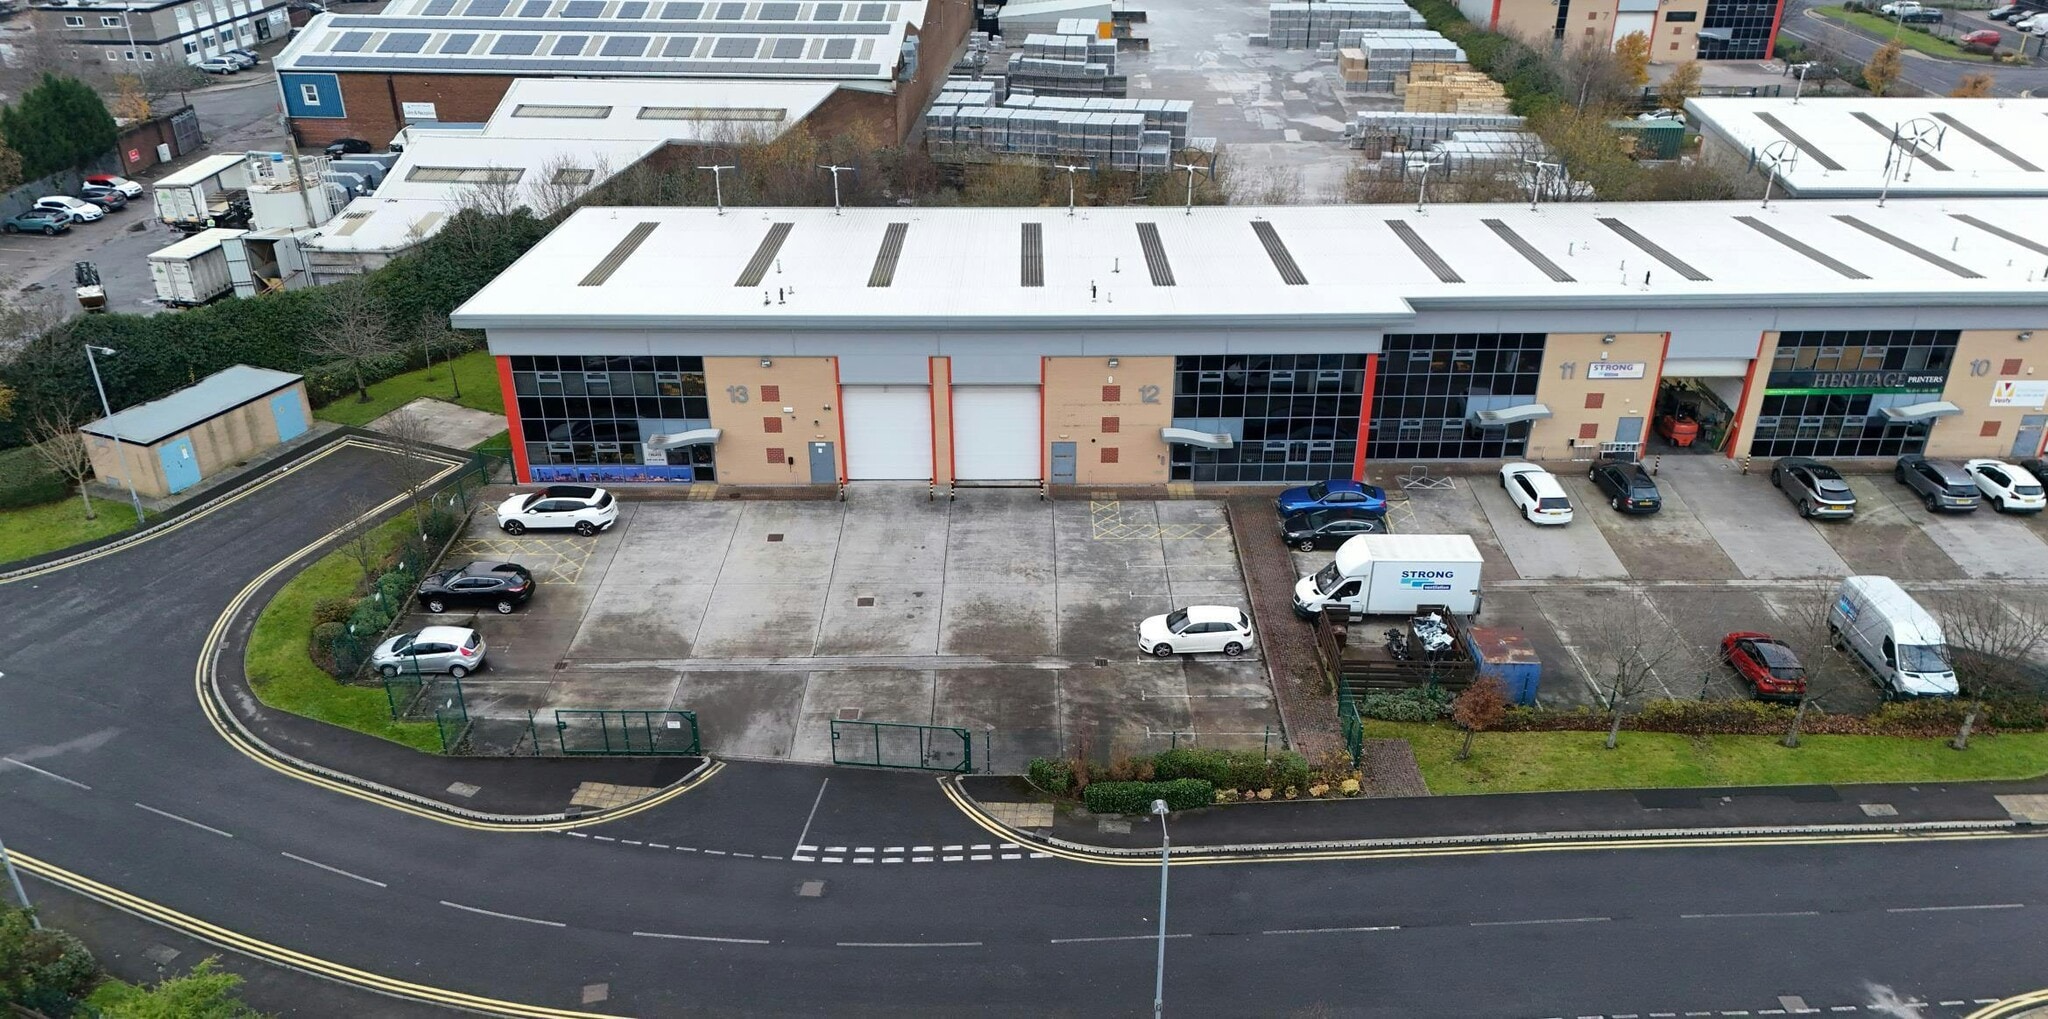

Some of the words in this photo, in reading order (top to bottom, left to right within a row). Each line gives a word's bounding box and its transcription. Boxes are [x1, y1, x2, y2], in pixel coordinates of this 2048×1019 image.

[1559, 362, 1576, 380] 11
[1970, 359, 1990, 377] 10
[1813, 372, 1907, 388] HERITAGE
[1907, 375, 1943, 383] PRINTERS
[726, 385, 749, 403] 13
[1138, 384, 1161, 404] 12
[1401, 570, 1454, 578] STRONG
